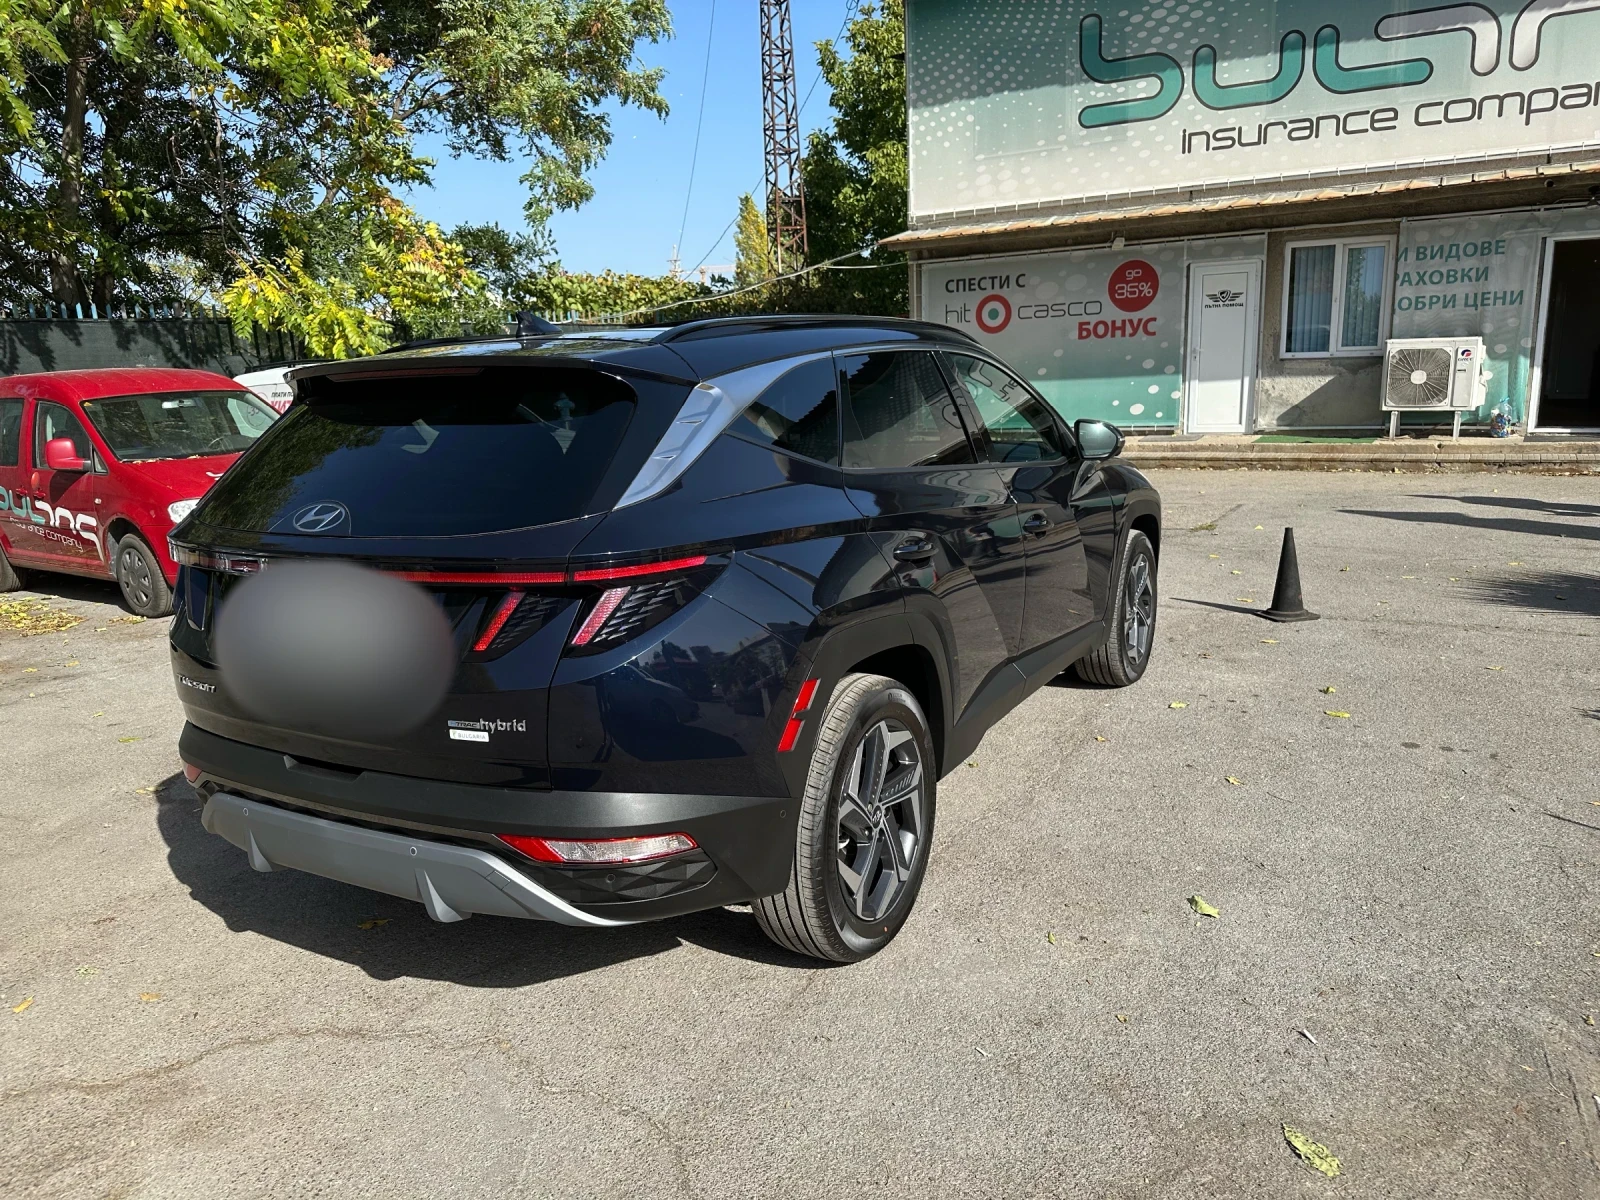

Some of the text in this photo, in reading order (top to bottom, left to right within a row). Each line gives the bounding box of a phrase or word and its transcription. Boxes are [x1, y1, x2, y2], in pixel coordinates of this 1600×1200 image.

[1181, 80, 1600, 155] insurance compa
[1415, 239, 1506, 262] ВИДОВЕ
[944, 273, 1026, 293] СПЕСТИ С
[1115, 282, 1153, 299] 35%
[1394, 289, 1525, 312] ОБРИ ЦЕНИ
[945, 301, 1102, 324] hit casco
[1077, 317, 1157, 340] БОНУС
[480, 718, 526, 734] hybrid
